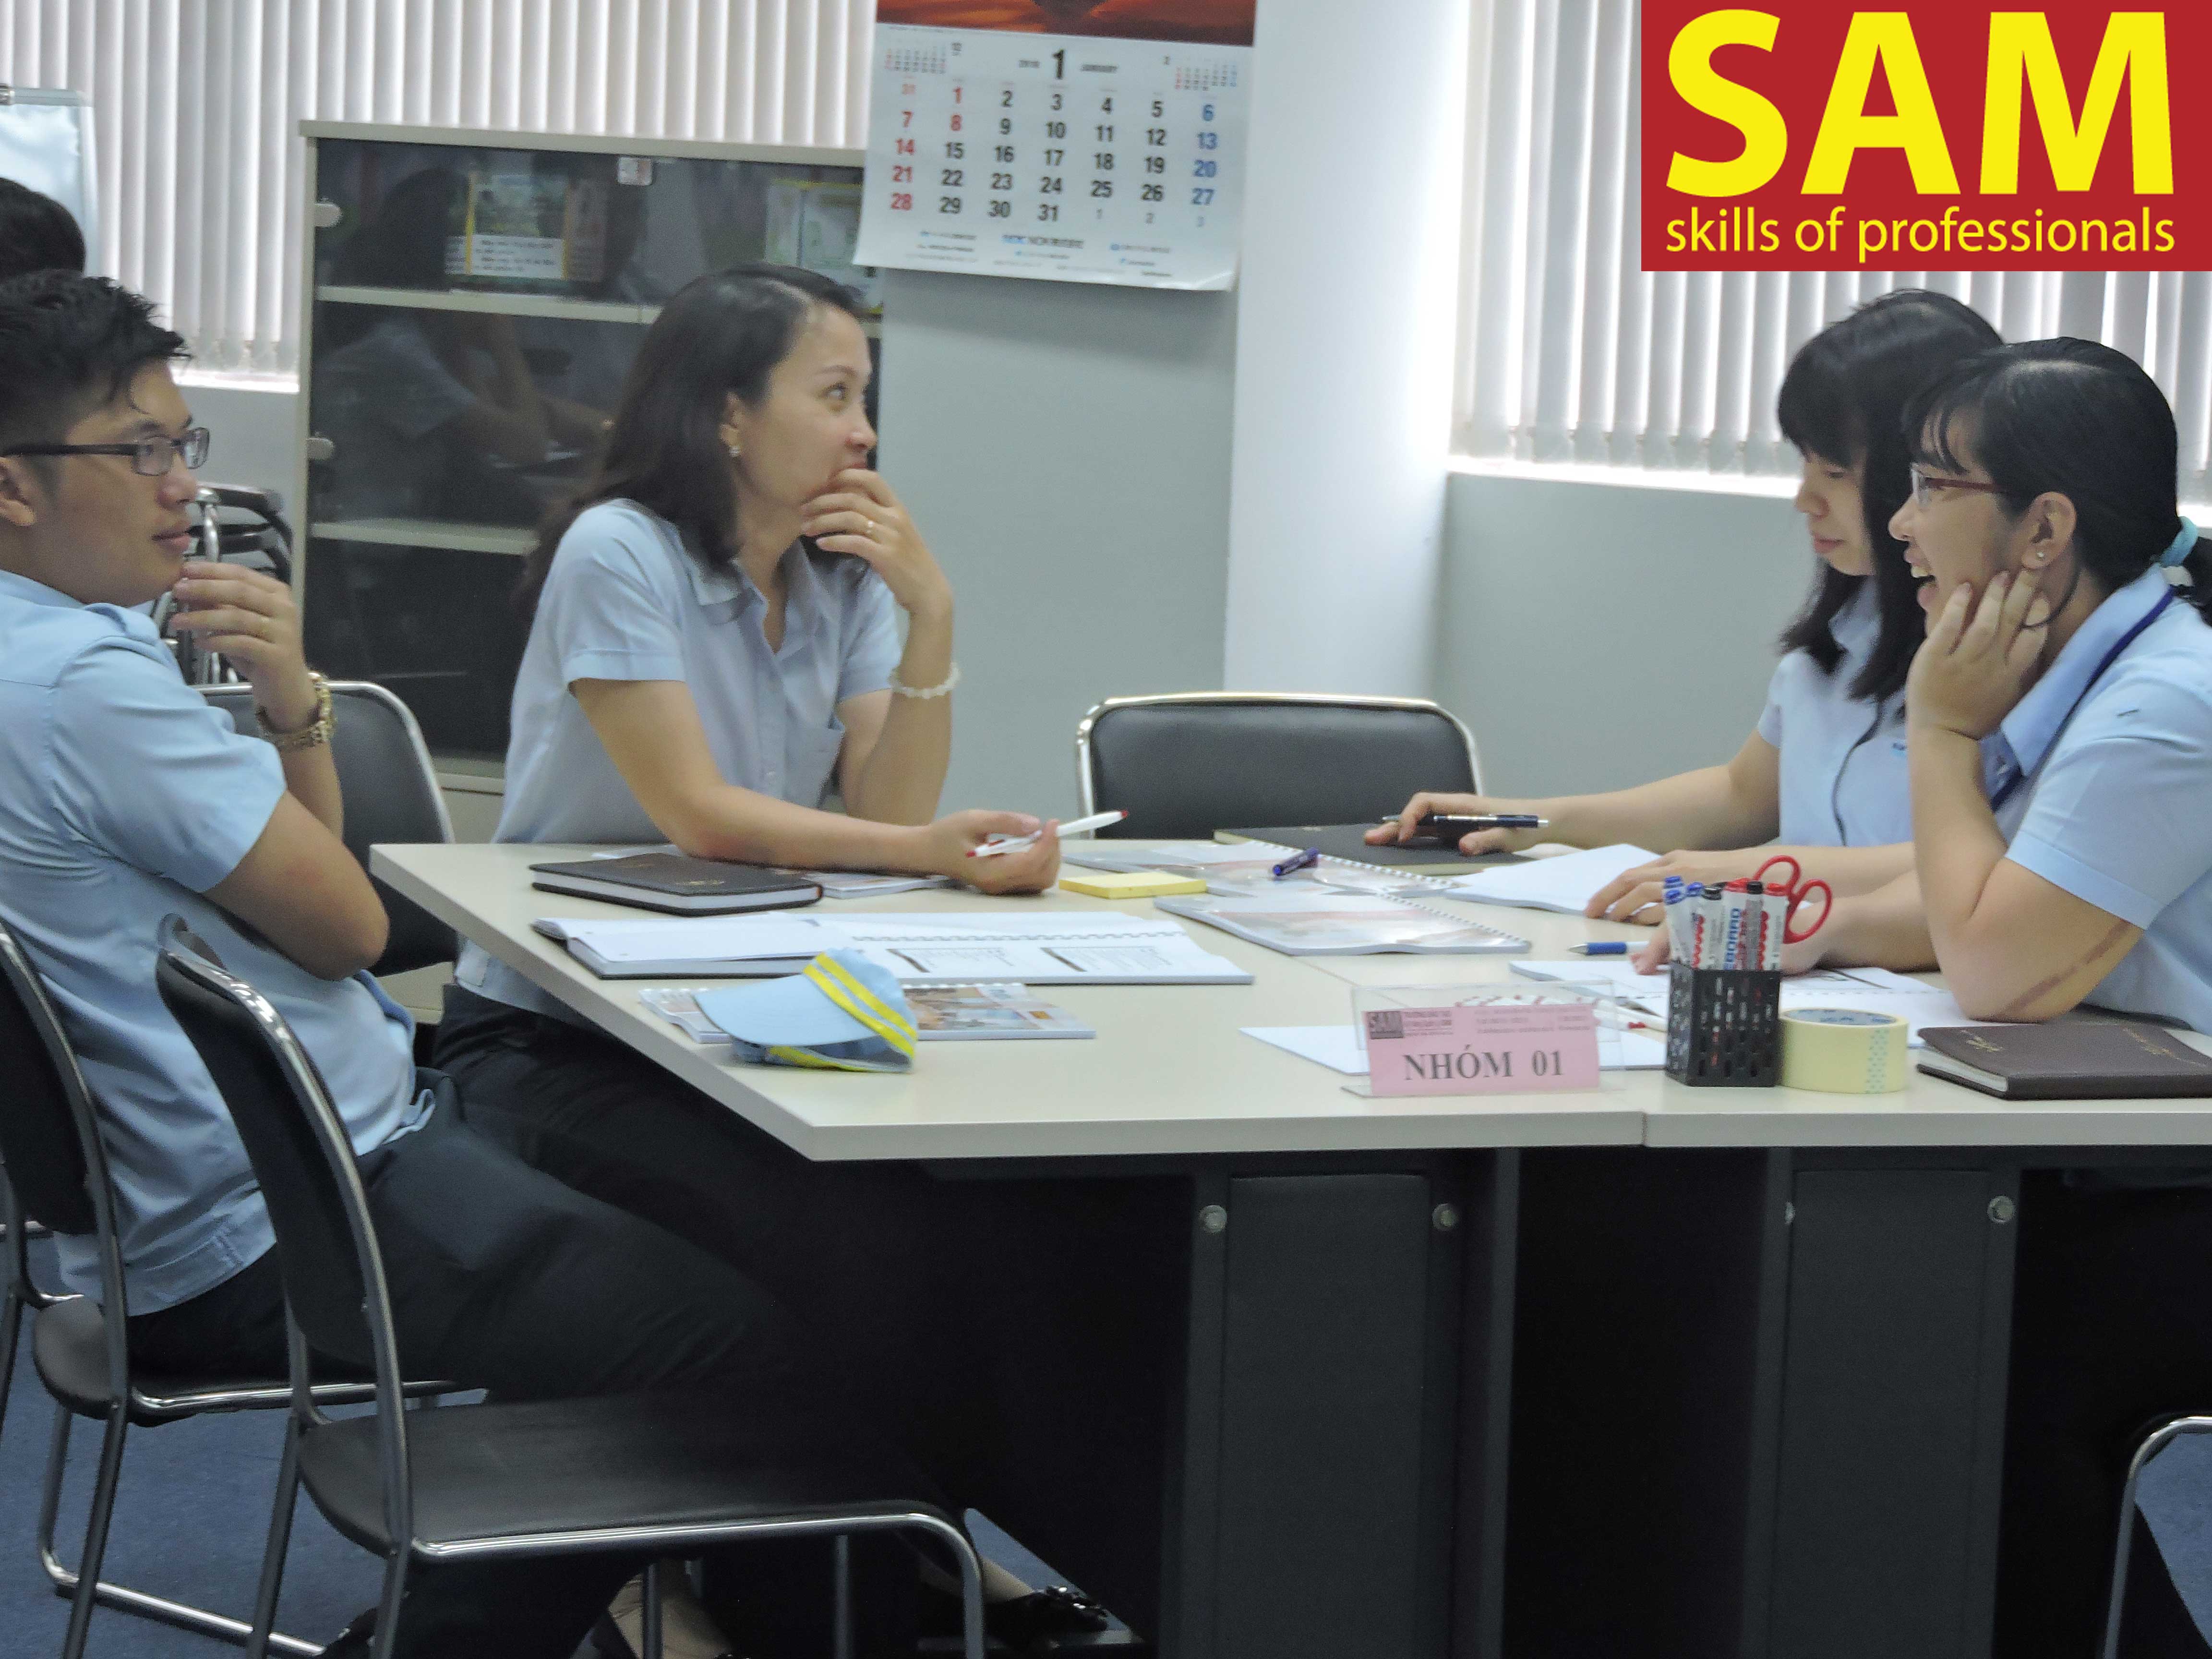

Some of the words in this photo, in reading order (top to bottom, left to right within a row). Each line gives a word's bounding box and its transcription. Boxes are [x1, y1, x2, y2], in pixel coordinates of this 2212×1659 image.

[1053, 48, 1064, 79] 1
[953, 86, 962, 104] 1
[1001, 90, 1013, 108] 2
[1051, 93, 1063, 111] 3
[1101, 97, 1113, 115] 4
[1152, 100, 1163, 118] 5
[1202, 104, 1214, 122] 6
[902, 110, 914, 128] 7
[950, 114, 962, 132] 8
[1000, 117, 1012, 135] 9
[1046, 121, 1067, 139] 10
[1096, 124, 1114, 143] 11
[1146, 128, 1166, 146] 12
[1197, 132, 1218, 150] 13
[896, 138, 915, 156] 14
[945, 142, 964, 160] 15
[994, 145, 1014, 163] 16
[1044, 149, 1064, 166] 17
[1094, 153, 1114, 170] 18
[1145, 156, 1165, 174] 19
[1193, 159, 1217, 178] 20
[892, 165, 913, 182] 21
[941, 168, 963, 187] 22
[990, 172, 1013, 191] 23
[1039, 176, 1062, 194] 24
[1090, 179, 1113, 198] 25
[1141, 183, 1164, 202] 26
[1191, 187, 1215, 205] 27
[890, 192, 913, 211] 28
[939, 196, 962, 215] 29
[988, 200, 1011, 218] 30
[1037, 203, 1059, 222] 31
[1403, 1045, 1514, 1080] NHÓM
[1532, 1050, 1563, 1077] 01
